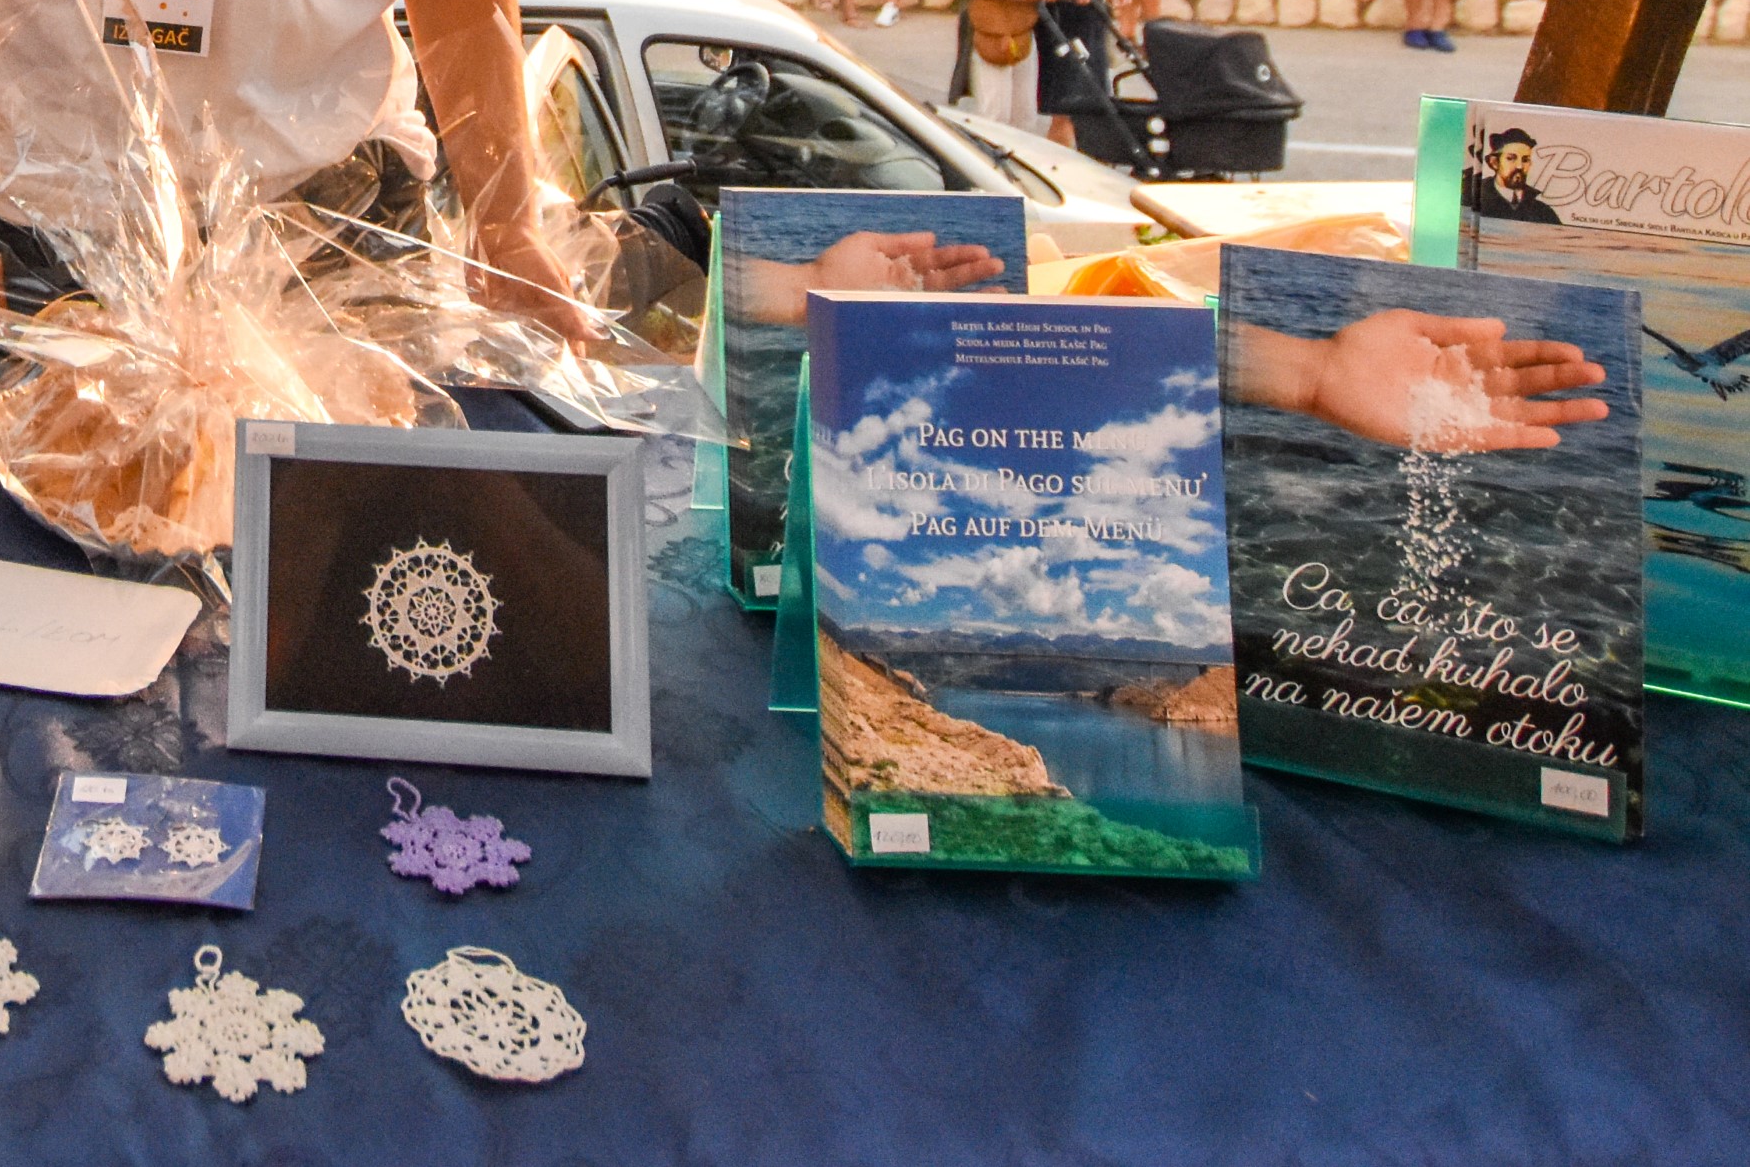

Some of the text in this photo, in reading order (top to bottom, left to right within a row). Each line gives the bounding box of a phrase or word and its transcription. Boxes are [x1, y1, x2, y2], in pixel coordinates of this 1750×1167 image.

[113, 25, 190, 46] IZGAČ
[1534, 144, 1750, 225] Bartol
[955, 337, 991, 347] SCUOLA
[993, 339, 1021, 348] MEDIA
[1090, 340, 1108, 350] PAG
[1042, 322, 1079, 333] SCHOOL
[1081, 325, 1092, 333] IN
[1094, 324, 1112, 334] PAG
[1092, 356, 1109, 367] PAG
[918, 422, 964, 448] PAG
[971, 429, 1008, 449] ON
[1015, 429, 1065, 450] THE
[866, 465, 957, 492] L'ISOLA
[964, 471, 989, 493] DI
[997, 468, 1064, 494] PAGO
[1071, 475, 1118, 496] SUL
[910, 511, 1163, 542] PAG AUF DEM MENÜ
[1453, 596, 1519, 641] što
[1532, 622, 1580, 653] se
[1273, 618, 1590, 707] nekad kuhalo
[1246, 671, 1618, 767] na našem otoku
